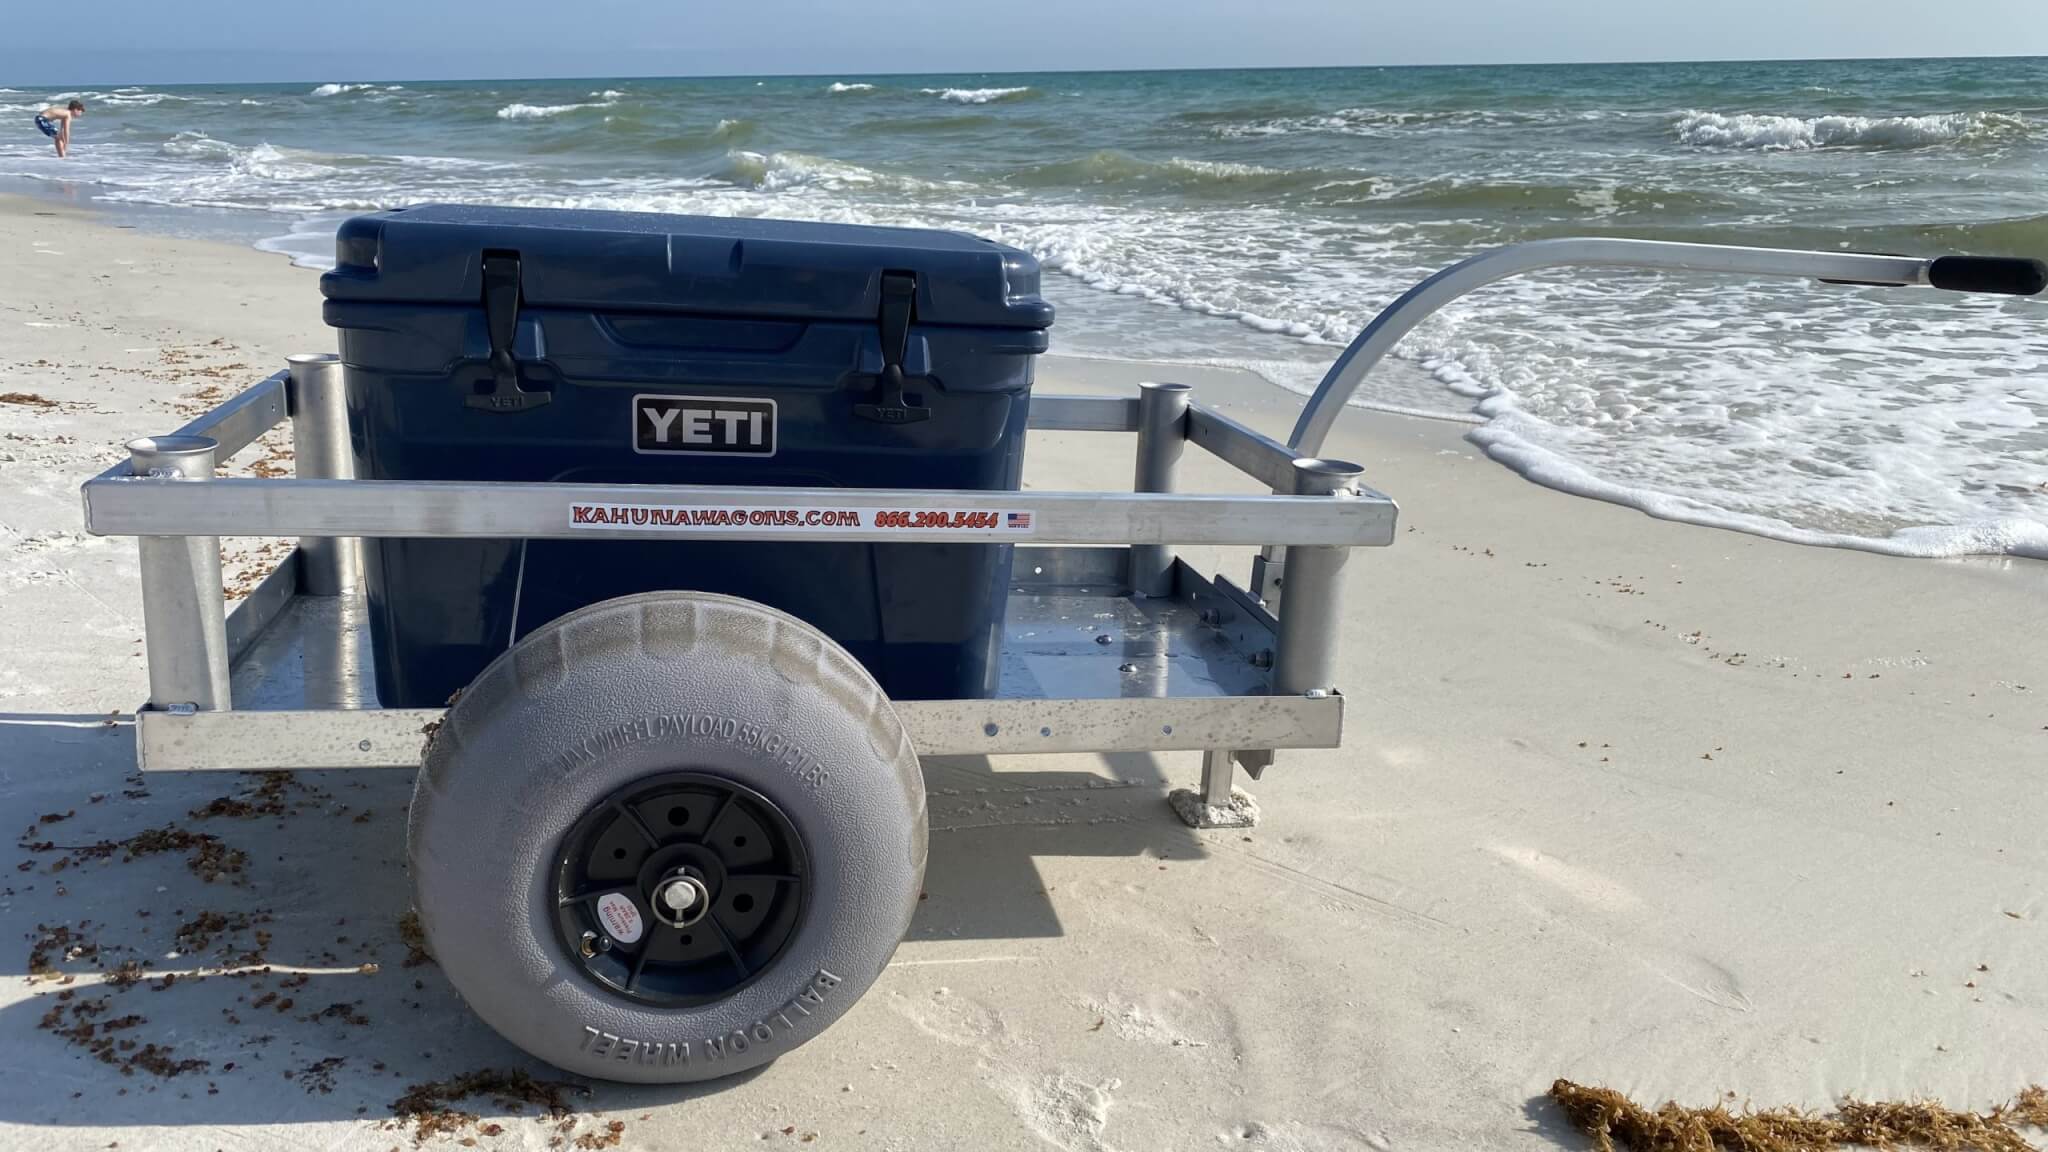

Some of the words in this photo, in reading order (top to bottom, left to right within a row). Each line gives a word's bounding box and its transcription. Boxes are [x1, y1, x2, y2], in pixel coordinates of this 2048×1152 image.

[491, 396, 524, 408] YETI
[642, 407, 763, 445] YETI
[573, 506, 860, 527] KAHUNAWAGONS.COM
[874, 511, 999, 528] 866.200.5454
[659, 714, 737, 739] PAYLOAD
[704, 968, 842, 1063] BALLOON
[583, 1024, 692, 1065] WHEEL
